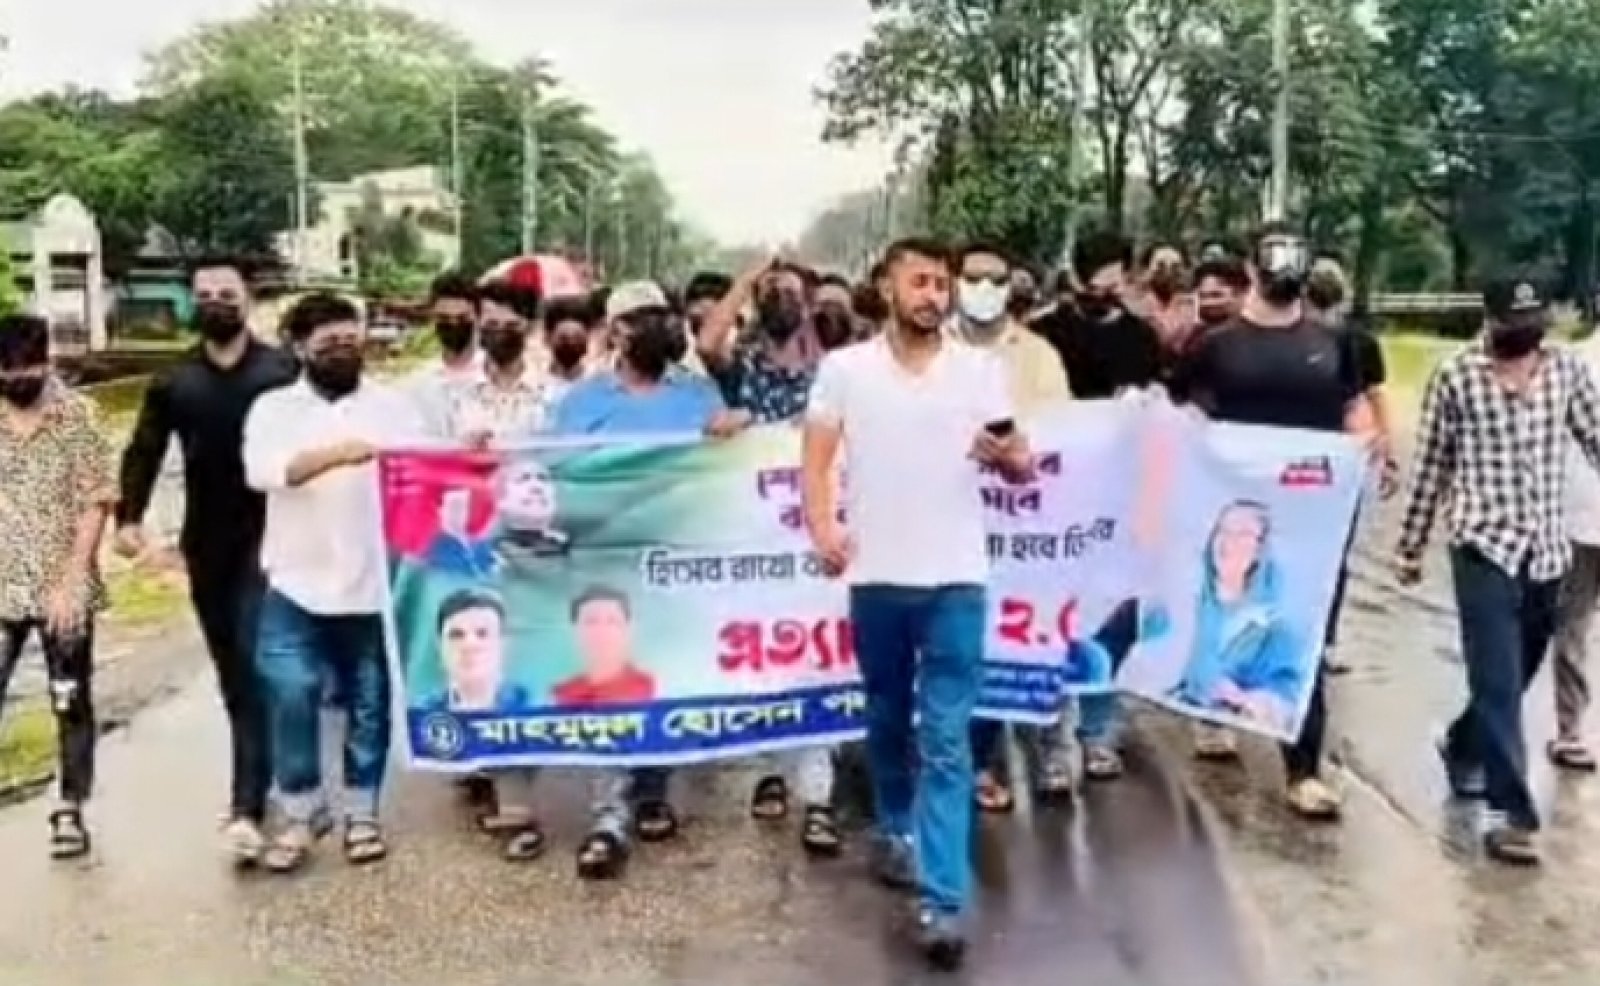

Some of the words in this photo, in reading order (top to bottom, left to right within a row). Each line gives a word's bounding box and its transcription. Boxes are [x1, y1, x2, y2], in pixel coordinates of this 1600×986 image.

[716, 617, 854, 673] প্রত্যা
[470, 712, 648, 751] মাহমুদুল
[661, 697, 803, 738] হোসেন
